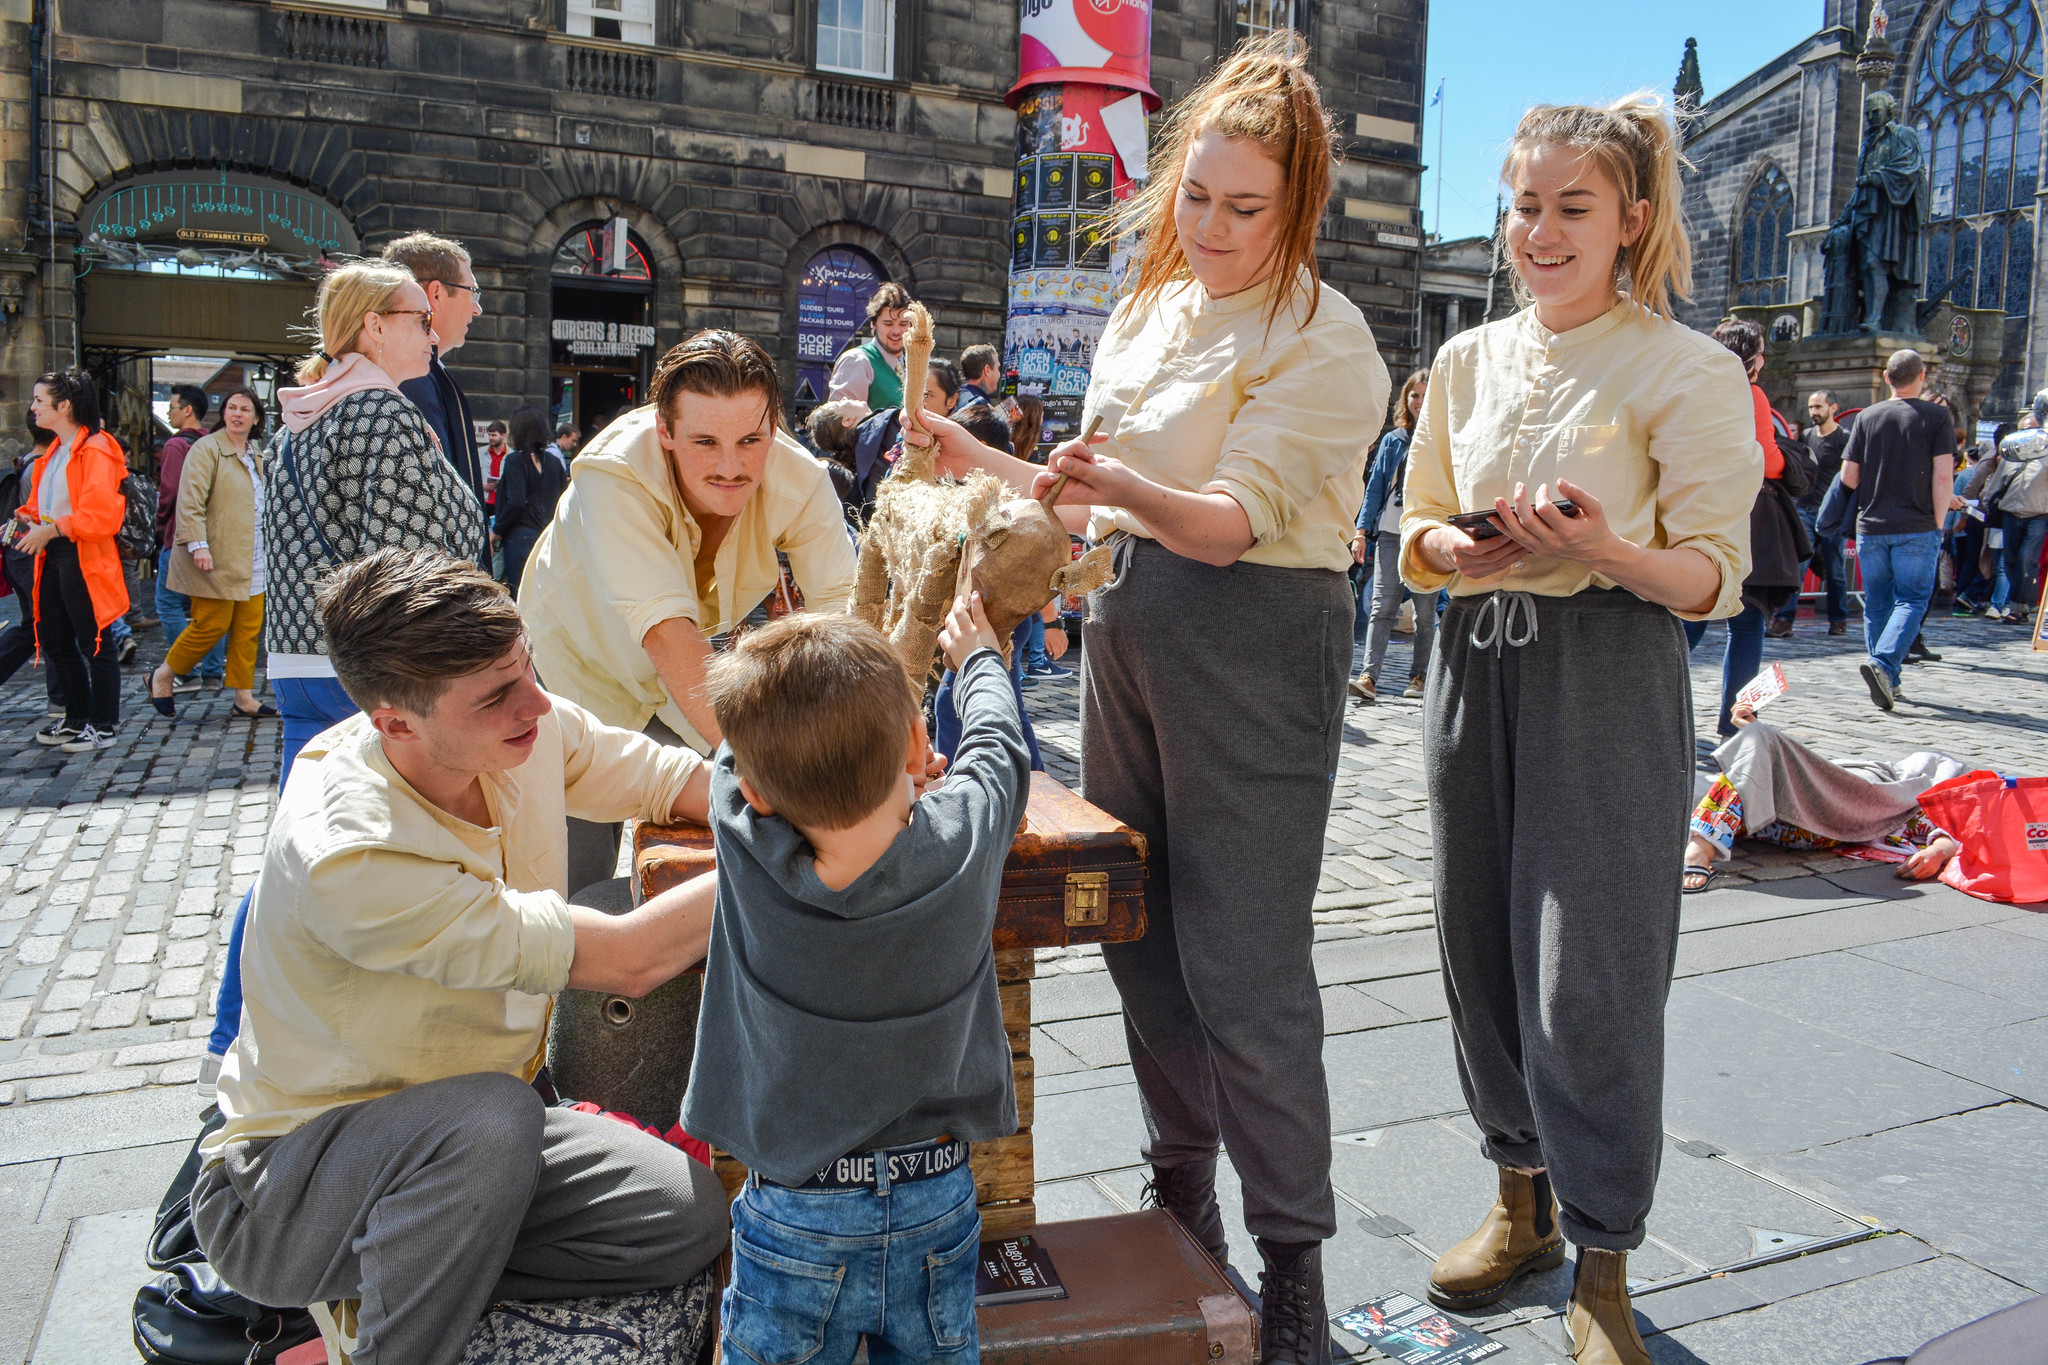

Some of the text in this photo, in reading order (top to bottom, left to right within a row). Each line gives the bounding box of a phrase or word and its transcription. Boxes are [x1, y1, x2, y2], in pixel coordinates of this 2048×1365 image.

[180, 230, 265, 243] OLD FISHMARKET CLOSE
[800, 304, 823, 312] GUIDED
[834, 319, 854, 327] TOURS
[552, 319, 656, 346] BURGERS & BEERS
[799, 333, 833, 346] BOOK
[572, 341, 637, 357] GRILLHOUSE
[799, 344, 833, 357] HERE
[1024, 352, 1050, 363] OPEN
[1022, 363, 1050, 374] ROAD
[1057, 369, 1089, 384] OPEN
[1056, 380, 1087, 394] ROAD
[837, 1156, 899, 1183] GUES
[925, 1145, 951, 1174] LOS
[1004, 1241, 1027, 1267] Ingo's
[1018, 1267, 1036, 1285] War
[1482, 1341, 1503, 1353] PEER
